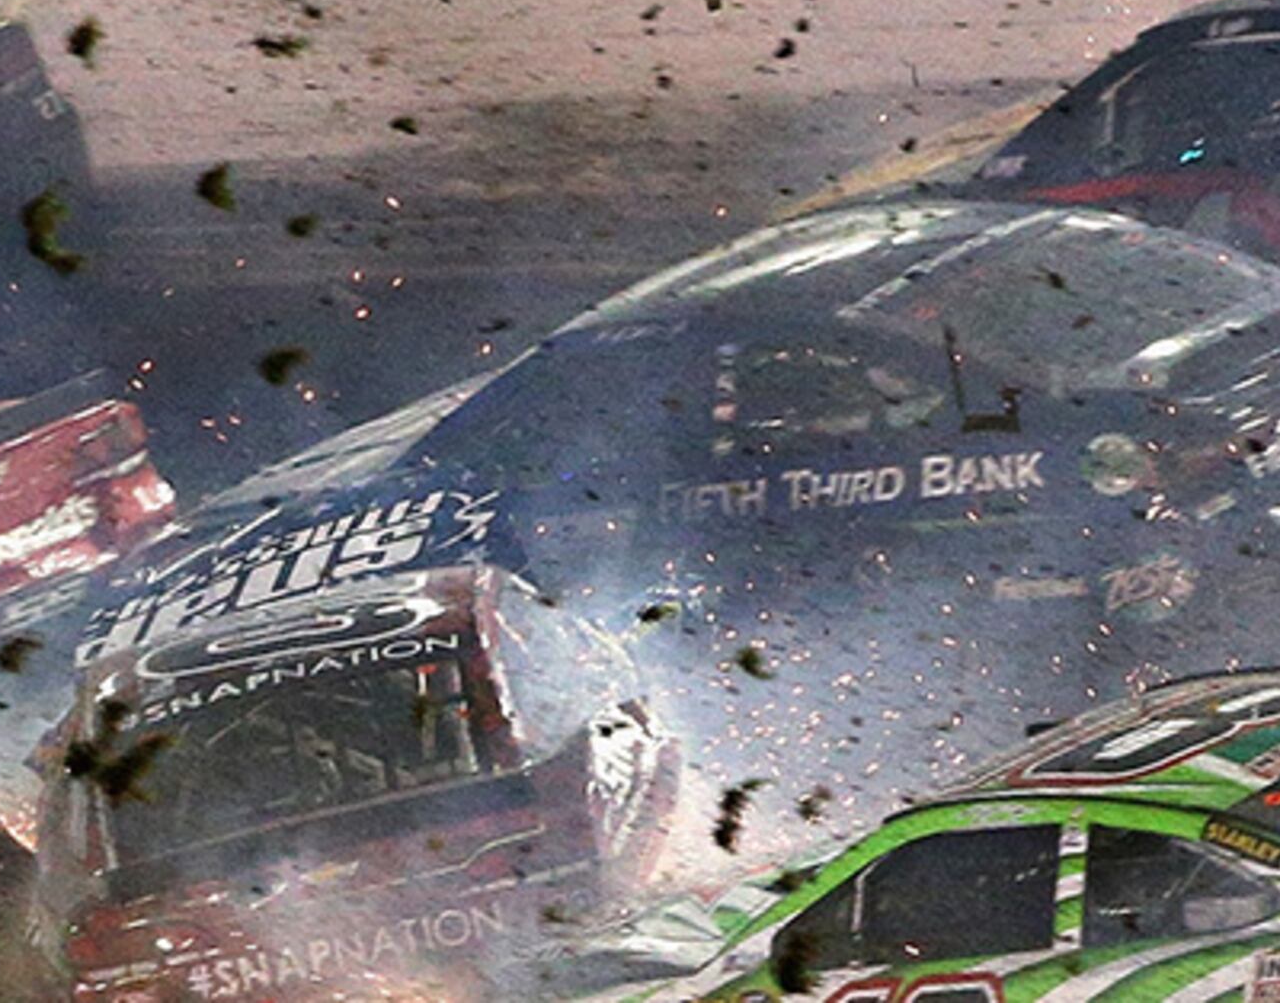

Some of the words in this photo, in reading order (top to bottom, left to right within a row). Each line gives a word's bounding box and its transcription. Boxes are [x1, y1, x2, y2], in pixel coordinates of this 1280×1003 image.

[660, 478, 768, 518] FIFTH
[780, 468, 907, 511] THIRD
[921, 450, 1047, 499] BANK
[187, 901, 504, 998] #SNAPNATION
